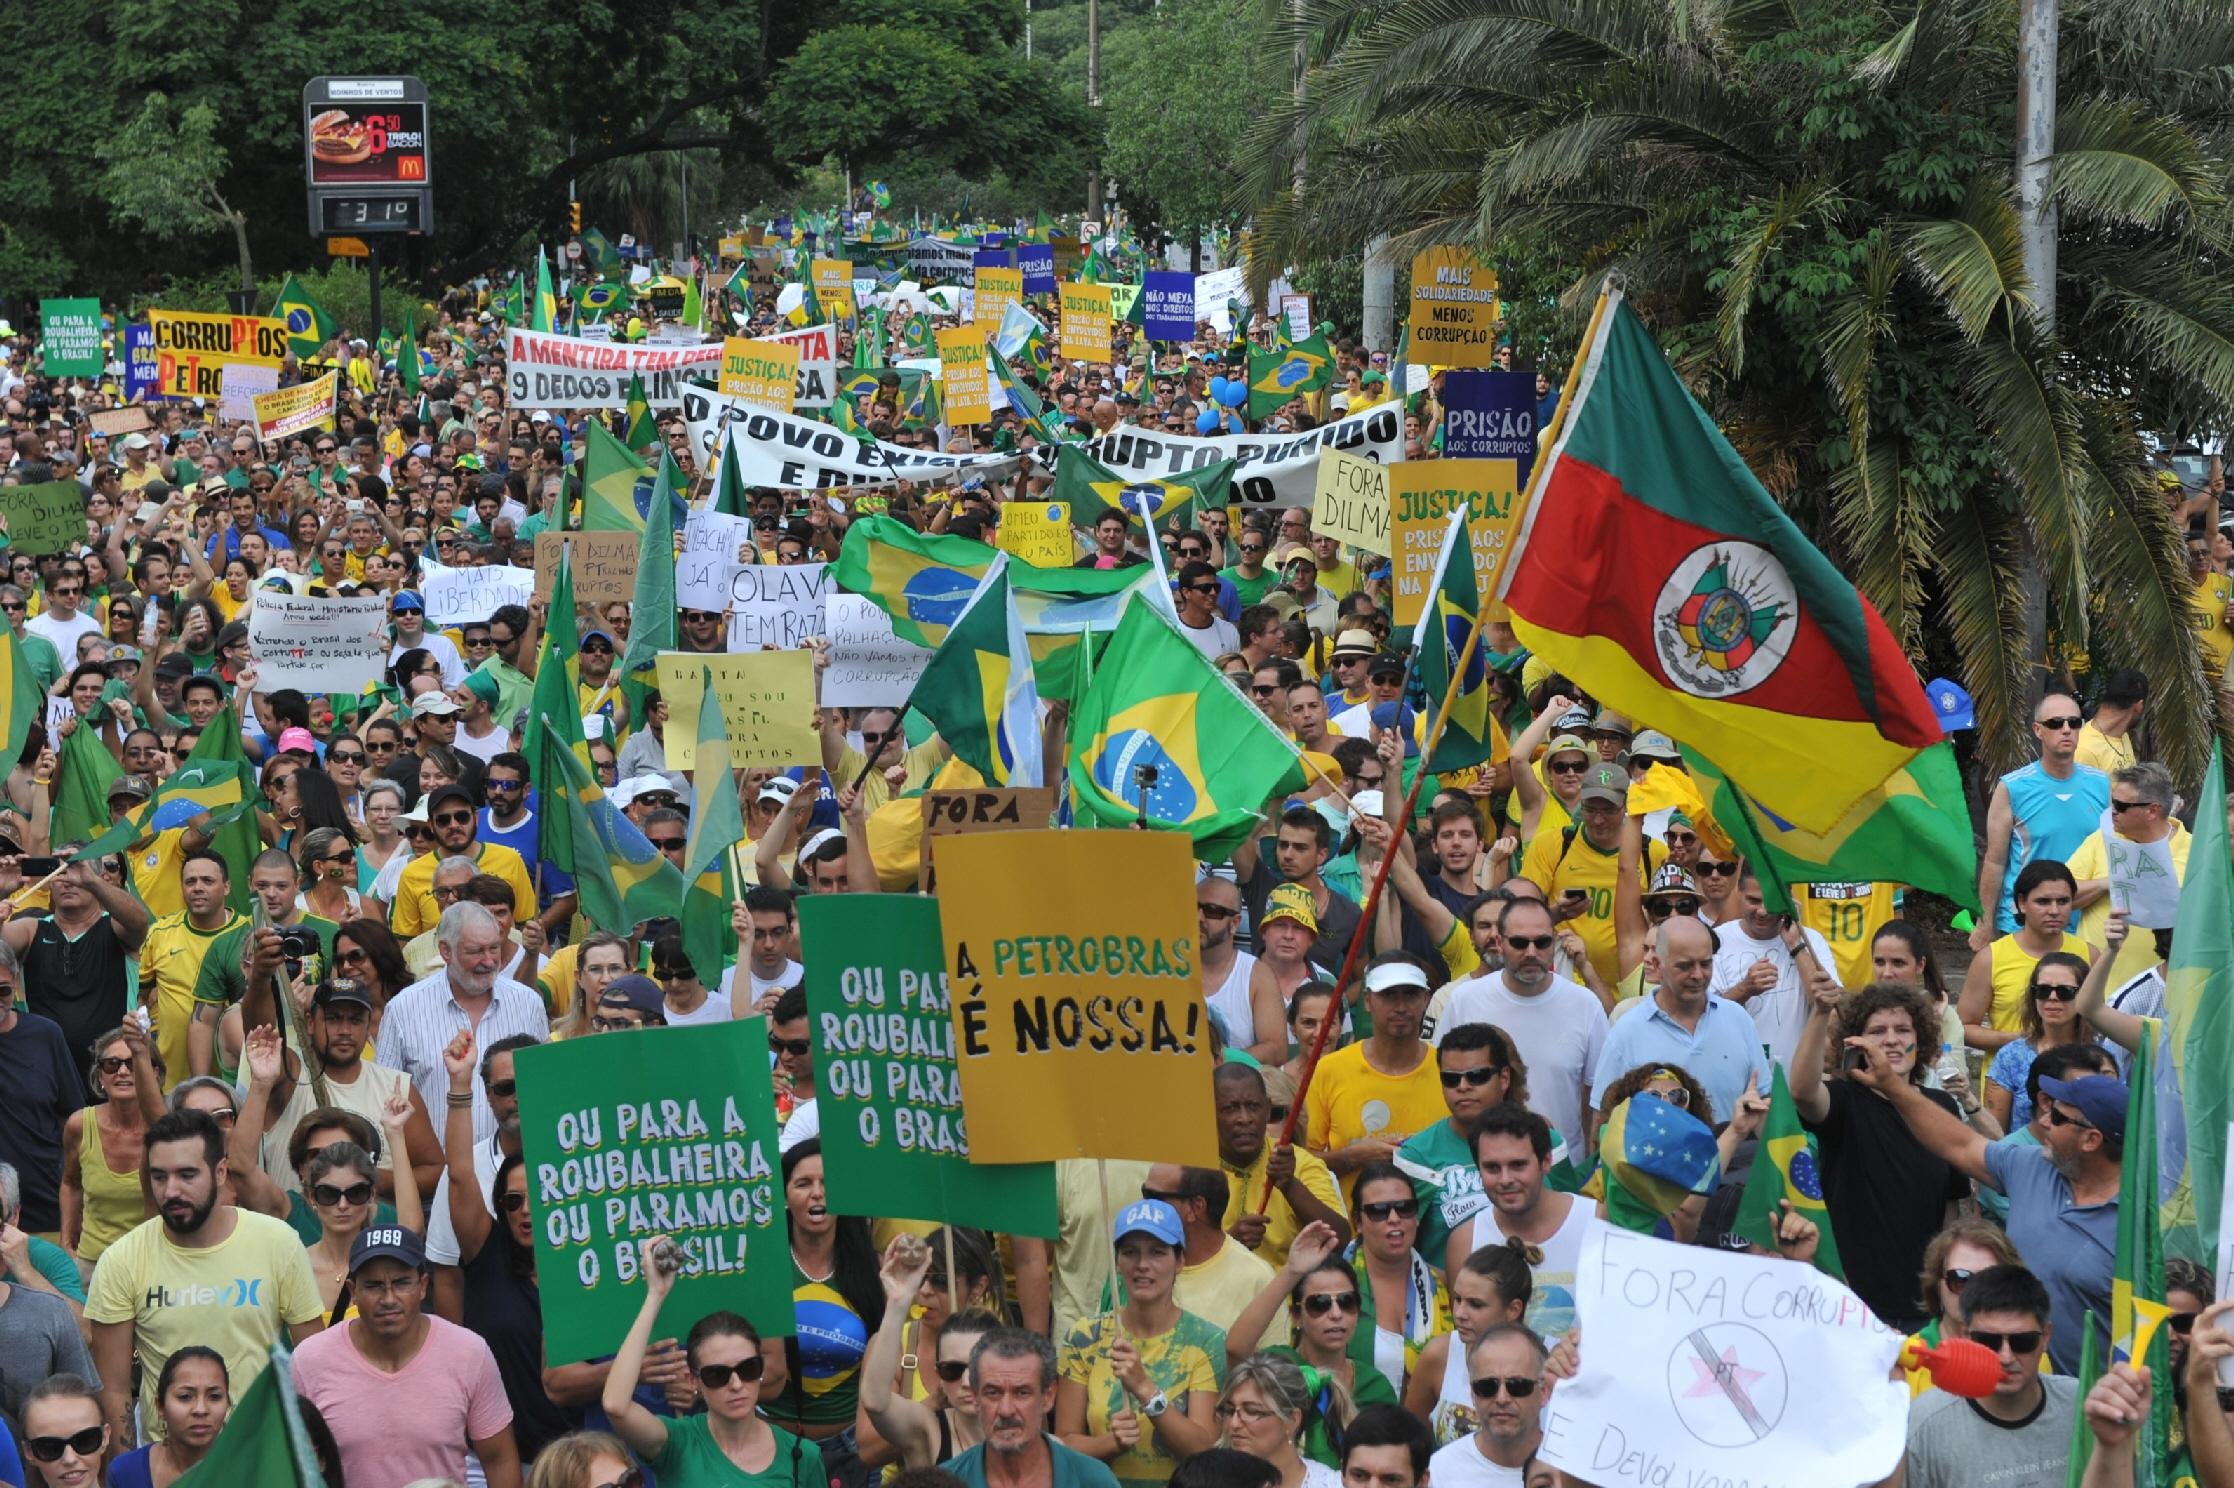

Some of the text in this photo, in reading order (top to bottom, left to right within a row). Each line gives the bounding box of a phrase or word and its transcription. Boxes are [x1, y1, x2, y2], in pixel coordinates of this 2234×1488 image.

[366, 115, 400, 154] 6 50
[387, 139, 422, 148] BACON
[946, 248, 972, 260] mais
[823, 270, 840, 278] MAIS
[1019, 258, 1053, 272] PRISÃO
[978, 279, 1020, 292] JUSTIÇA!
[1437, 266, 1472, 285] MAIS
[1146, 290, 1194, 304] NÃO MEXA
[1416, 285, 1494, 304] SOLIDARIEDADE
[1065, 296, 1109, 314] JUSTIÇA!
[1146, 304, 1194, 314] NOS DIREITOS
[50, 316, 94, 326] OU PARA A
[1066, 314, 1106, 326] PRISÃO AOS
[1432, 307, 1474, 324] MENOS
[45, 327, 99, 337] ROUBALHEIRA
[156, 318, 286, 358] CORRUPTOS
[1066, 325, 1106, 337] ENVOLVIDOS
[1416, 326, 1488, 345] CORRUPÇÃO
[46, 338, 99, 348] OU PARAMOS
[1064, 336, 1111, 348] NA LAVA JATO
[54, 349, 92, 359] O BRASIL!
[512, 335, 679, 371] A MENTIRA TEM
[943, 344, 983, 364] JUSTIÇA!
[302, 368, 324, 378] FIM
[726, 355, 796, 382] JUSTIÇA!
[947, 367, 982, 380] PRISÃO AOS
[513, 372, 528, 400] 9
[537, 372, 610, 400] DEDOS
[727, 380, 763, 396] PRISÃO
[767, 383, 788, 398] AOS
[947, 397, 956, 408] NA
[683, 393, 710, 422] O
[720, 404, 844, 458] POVO
[1236, 410, 1398, 469] PUNIDO
[1448, 408, 1532, 438] PRISÃO
[1447, 440, 1531, 454] AOS CORRUPTOS
[781, 462, 804, 486] E
[1336, 460, 1386, 501] FORA
[32, 502, 84, 522] DILMA
[10, 518, 83, 542] LEVE O PT
[1472, 530, 1504, 548] AOS
[542, 538, 579, 560] FOA
[1038, 542, 1066, 558] PAÍS
[454, 566, 504, 586] MAIS
[732, 569, 826, 602] OLAV
[1400, 576, 1422, 596] NA
[838, 604, 850, 622] O
[732, 610, 776, 646] TEM
[311, 635, 340, 644] Brasil
[346, 635, 362, 644] dos
[364, 650, 380, 660] que
[675, 669, 746, 681] BATA
[833, 666, 920, 685] CORRUPÇÃO
[750, 690, 786, 702] SOU
[928, 794, 1020, 828] FORA
[1587, 887, 1612, 920] 10
[1822, 888, 1840, 900] LEVE
[1830, 902, 1864, 942] 10
[957, 934, 1192, 981] A PETROBRAS
[841, 966, 885, 1009] OU
[963, 984, 1199, 1057] É NOSSA!
[828, 1059, 872, 1100] OU
[557, 1096, 746, 1153] OU PARA A
[858, 1105, 880, 1146] O
[538, 1140, 773, 1204] ROUBALHEIRA
[547, 1184, 773, 1249] OU PARAMOS
[1126, 1202, 1165, 1225] GAP
[578, 1233, 748, 1288] O BSIL!
[1601, 1230, 1727, 1318] FORA
[145, 1282, 233, 1310] Hurley
[1714, 1362, 1739, 1384] PT
[1542, 1412, 1576, 1459] E
